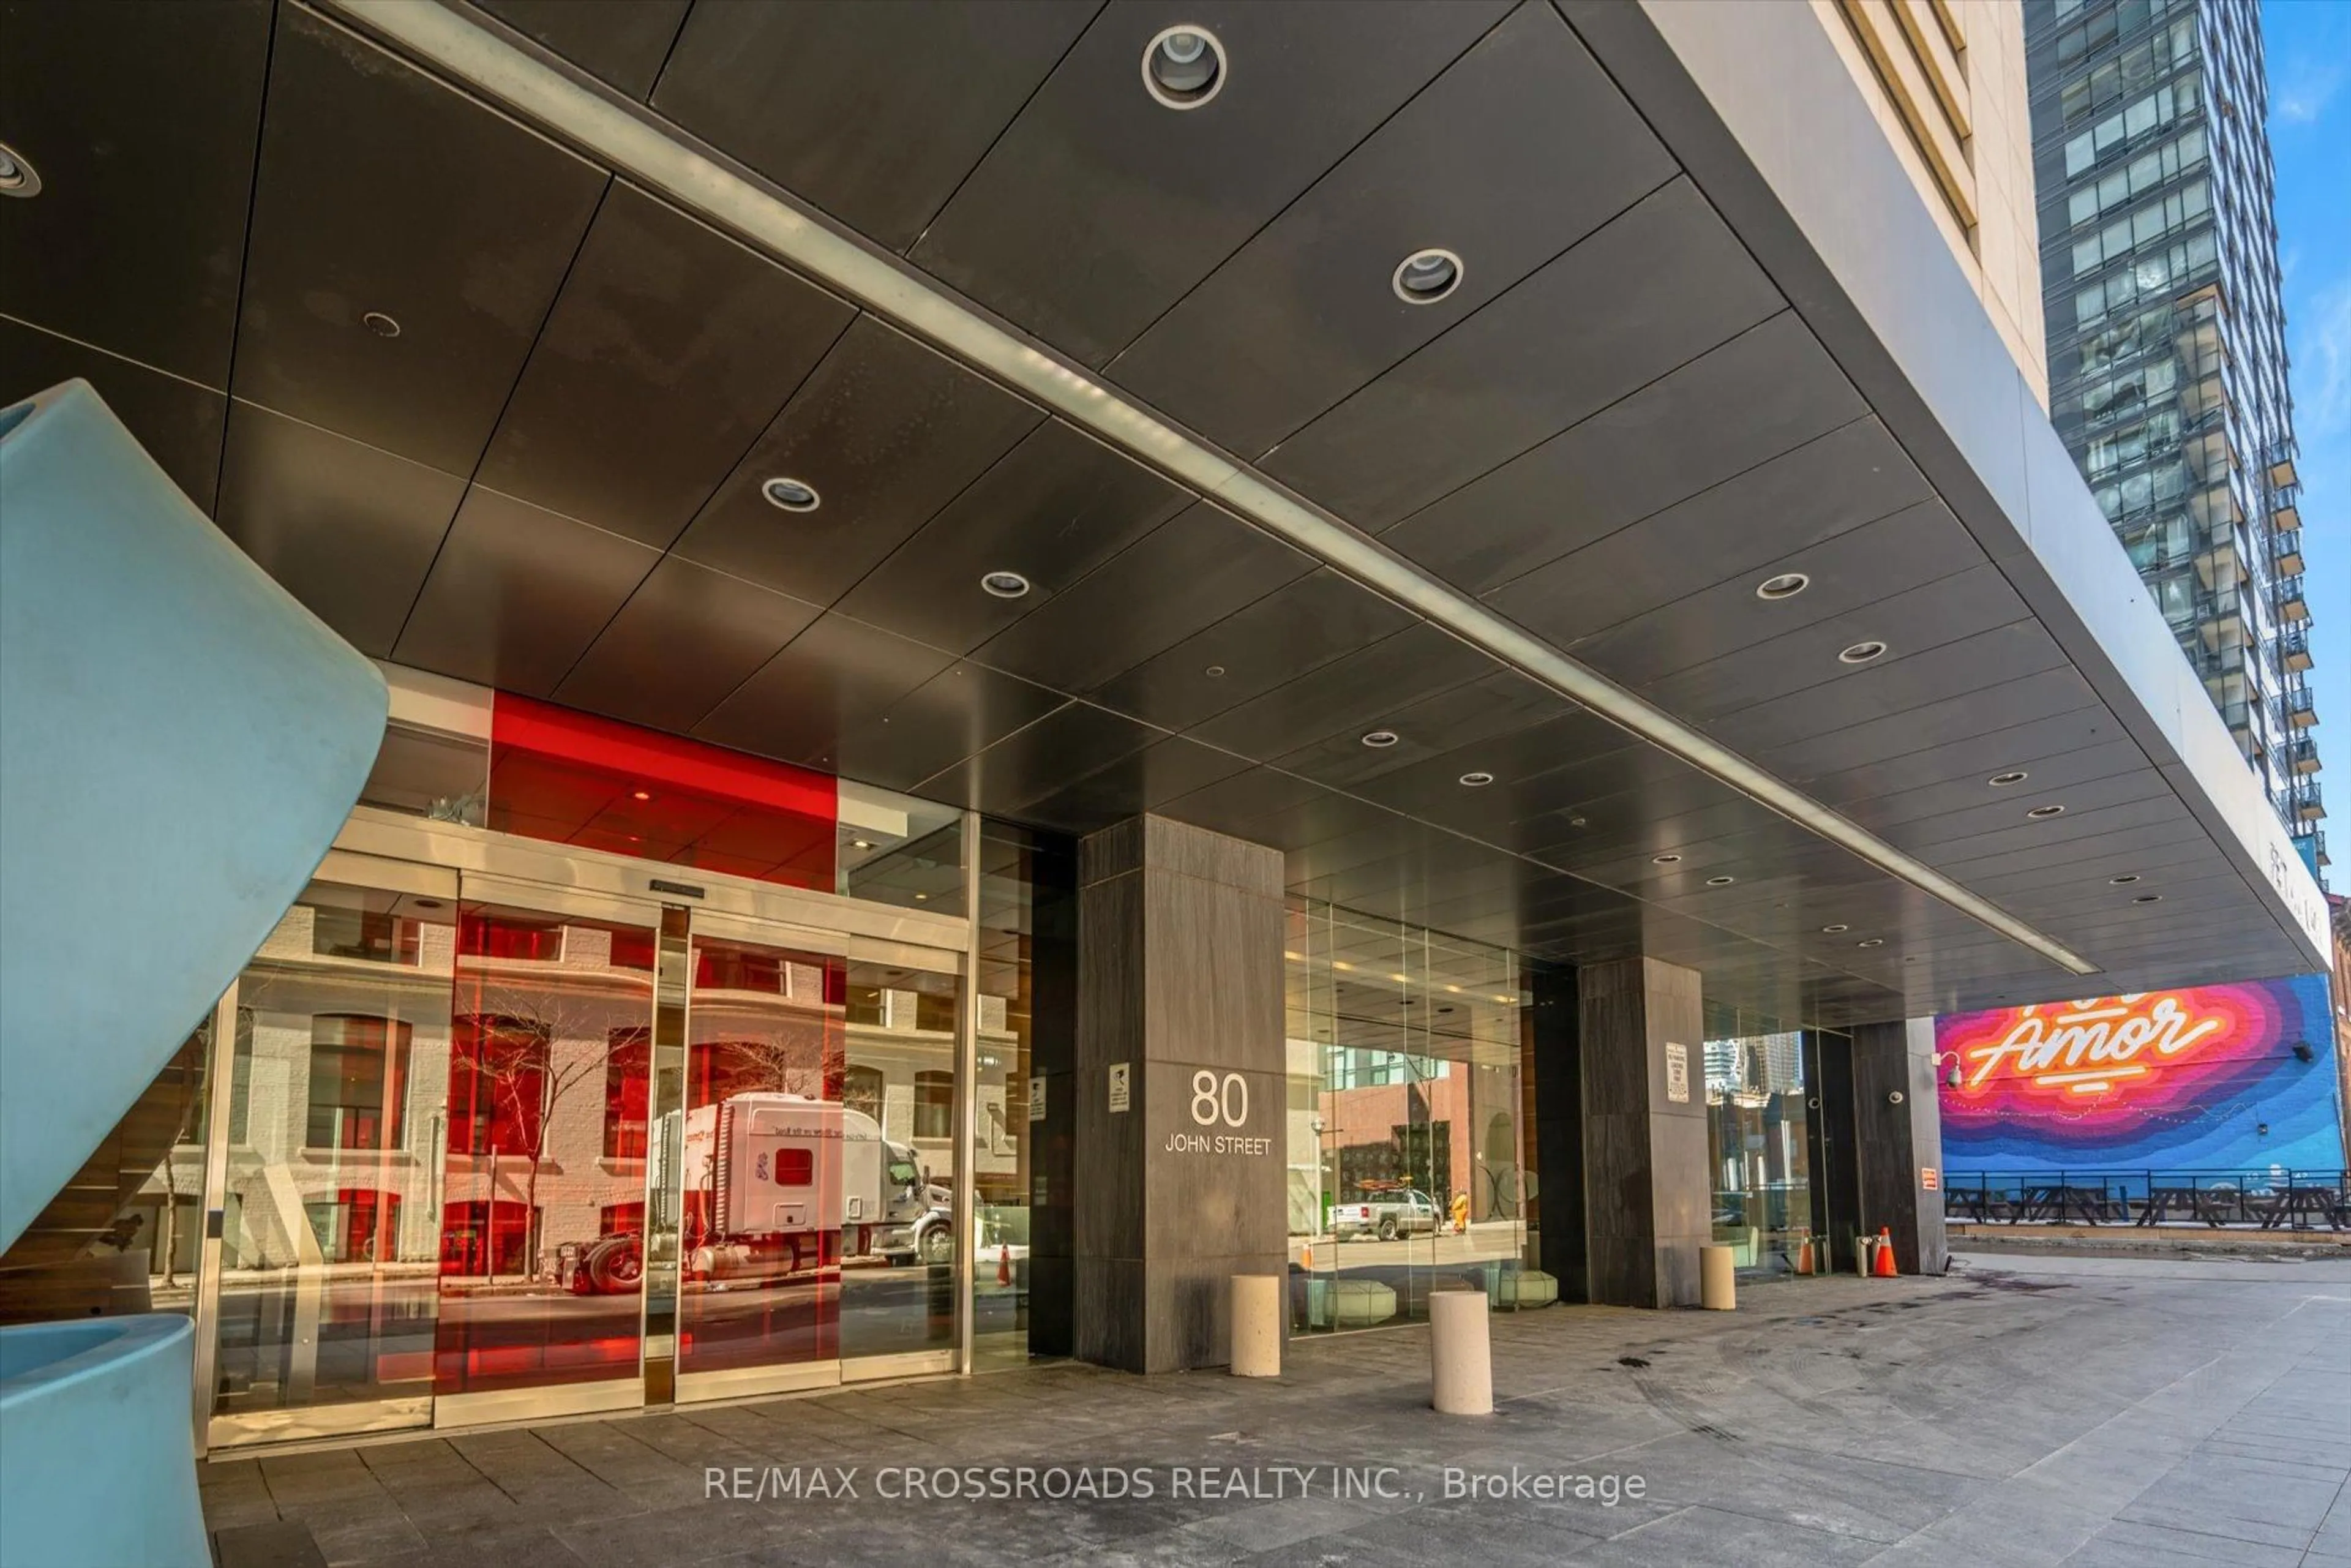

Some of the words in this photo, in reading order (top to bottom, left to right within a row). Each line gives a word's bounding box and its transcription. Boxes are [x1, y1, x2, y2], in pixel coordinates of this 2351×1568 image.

[1970, 997, 2218, 1086] Amor
[1191, 1070, 1248, 1127] 80
[1165, 1133, 1210, 1153] JOHN
[1214, 1136, 1272, 1155] STREET
